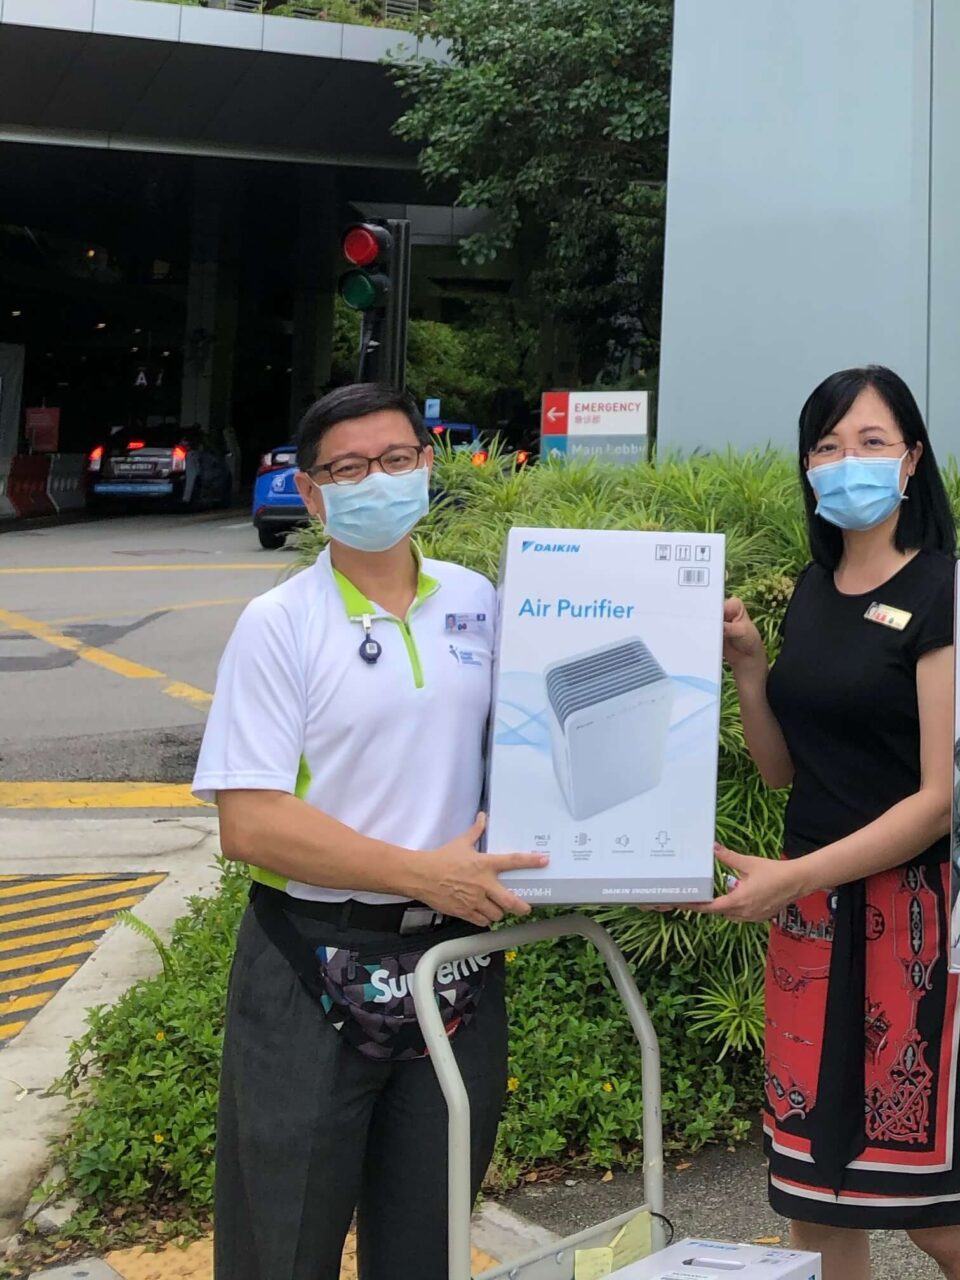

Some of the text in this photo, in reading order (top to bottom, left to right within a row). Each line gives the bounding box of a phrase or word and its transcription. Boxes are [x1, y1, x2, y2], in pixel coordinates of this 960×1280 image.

[574, 402, 642, 413] EMERGENCY
[533, 543, 581, 553] DAIKIN
[518, 598, 635, 619] Air Purifier
